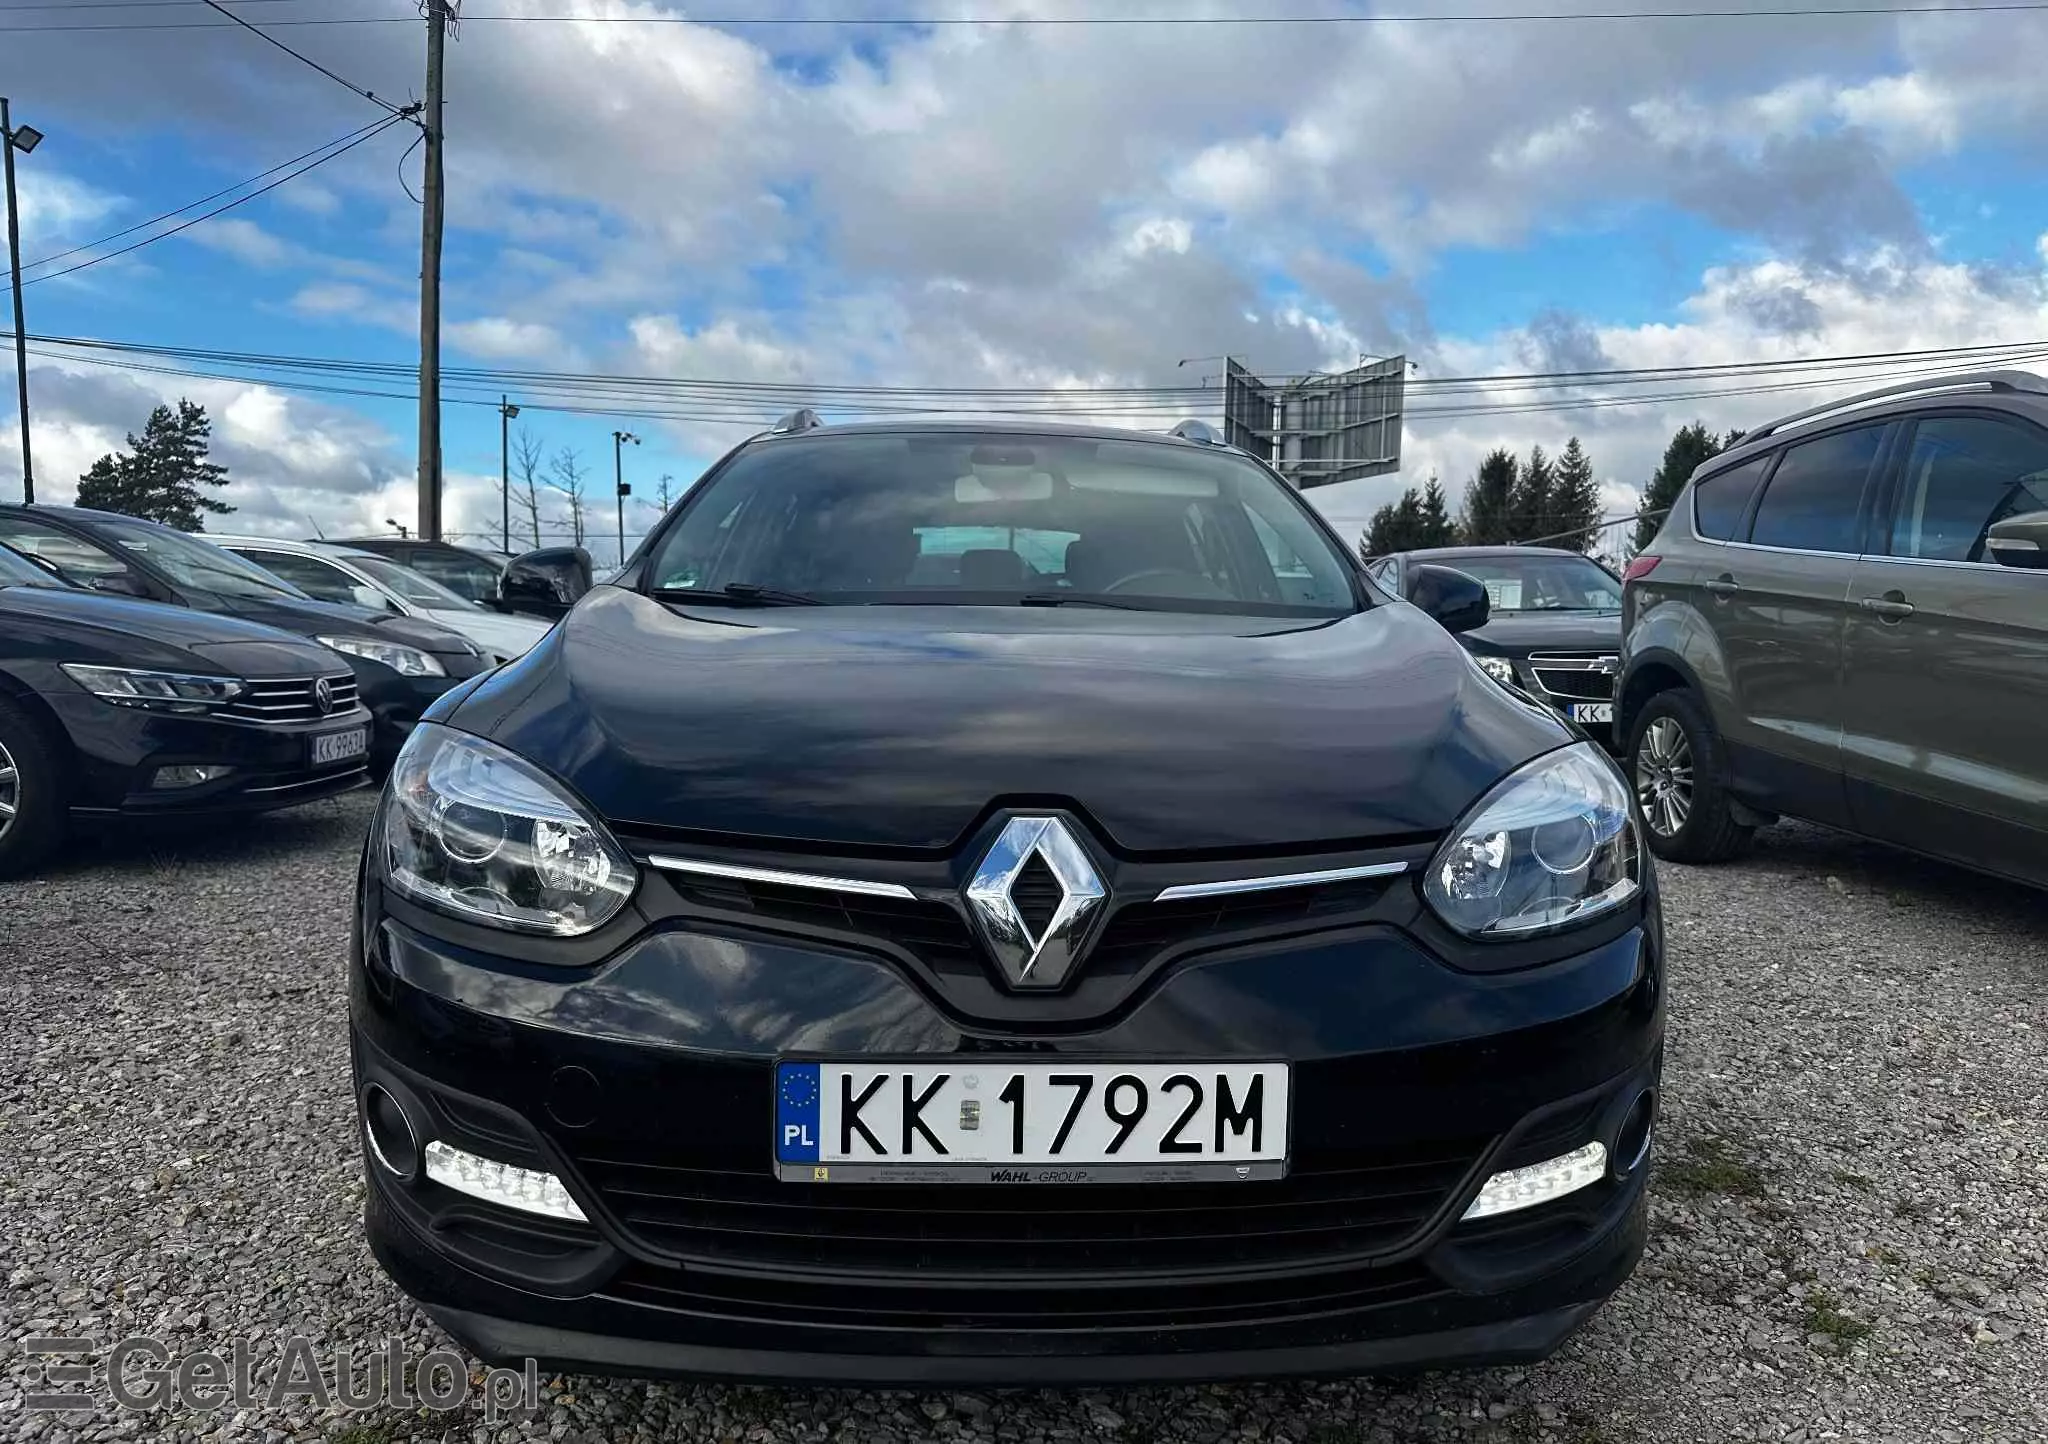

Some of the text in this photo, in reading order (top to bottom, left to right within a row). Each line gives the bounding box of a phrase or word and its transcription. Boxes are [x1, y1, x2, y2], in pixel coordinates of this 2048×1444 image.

[1577, 705, 1600, 721] KK
[319, 738, 333, 761] KK
[840, 1074, 1263, 1154] KK 1792M
[784, 1125, 814, 1146] PL
